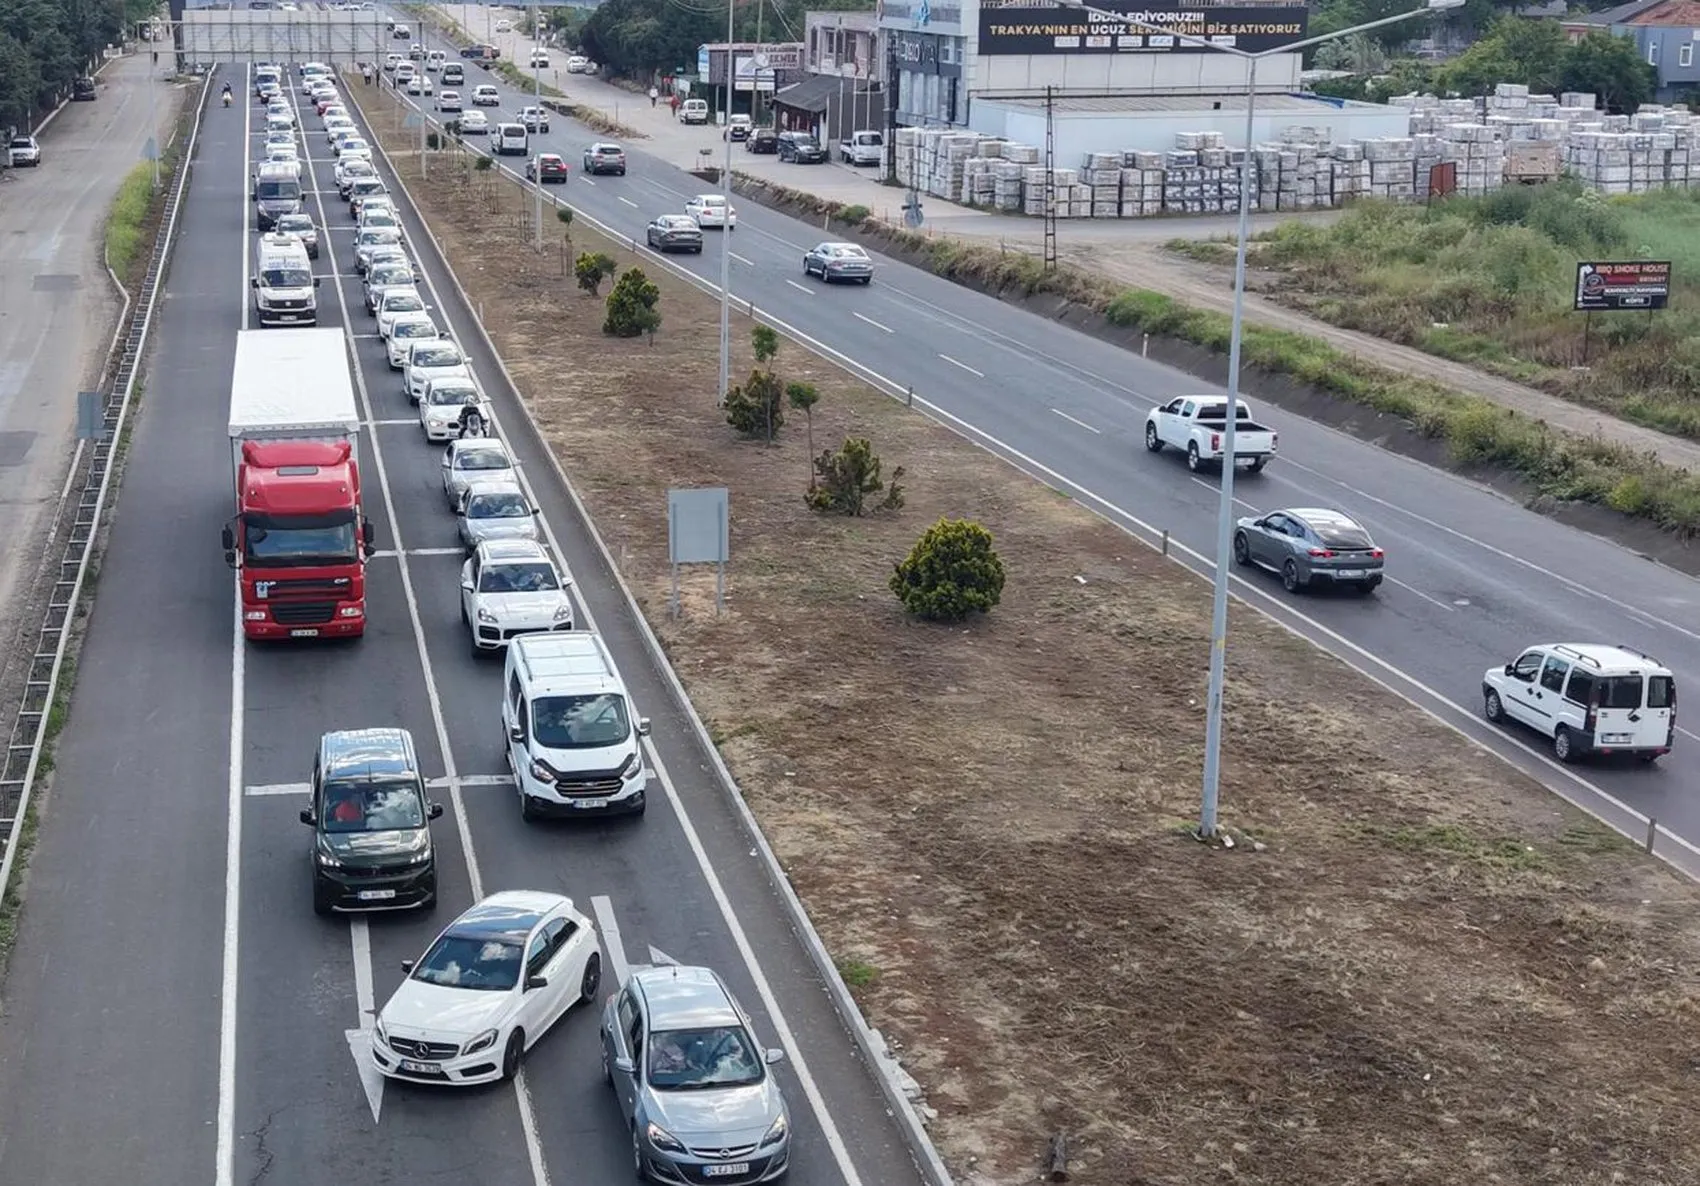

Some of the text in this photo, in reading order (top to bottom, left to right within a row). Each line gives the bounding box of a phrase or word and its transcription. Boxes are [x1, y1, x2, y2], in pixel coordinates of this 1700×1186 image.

[1127, 9, 1204, 22] EDİYORUZ!!!
[990, 24, 1068, 35] TRAKYA'NIN
[1070, 24, 1088, 35] EN
[1091, 24, 1126, 34] UCUZ
[1207, 21, 1227, 34] BİZ
[1230, 23, 1301, 34] SATIYORUZ
[1642, 264, 1668, 273] HOUSE
